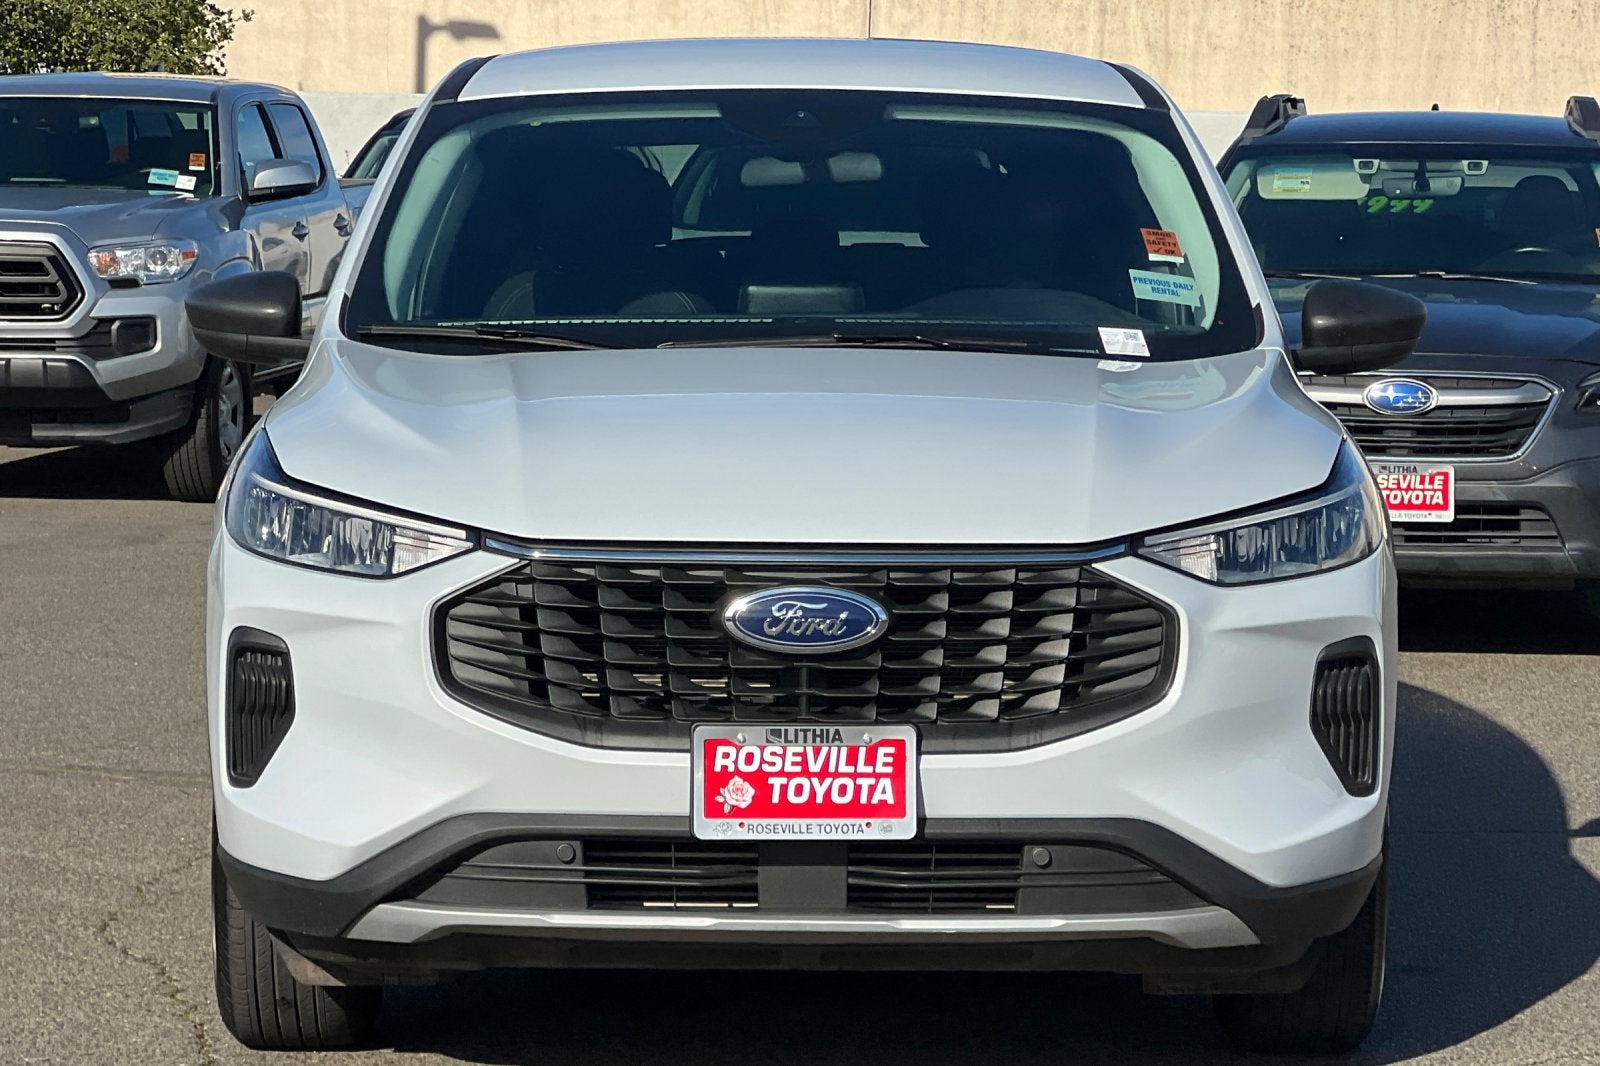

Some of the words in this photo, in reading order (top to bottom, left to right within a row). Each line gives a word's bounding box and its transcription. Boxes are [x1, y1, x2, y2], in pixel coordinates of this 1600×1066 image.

[1146, 239, 1177, 248] SAFETY
[1132, 276, 1171, 288] PREVIOUS
[1173, 282, 1194, 291] DAILY
[1151, 287, 1181, 297] RENTAL
[1388, 465, 1418, 474] LITHIA
[1377, 474, 1445, 490] SEVILLE
[763, 600, 849, 637] Ford
[783, 728, 844, 744] LITHIA
[713, 745, 896, 773] ROSEVILLE
[767, 777, 895, 805] TOYOTA
[747, 823, 813, 835] ROSEVILLE
[816, 823, 865, 835] TOYOTA
